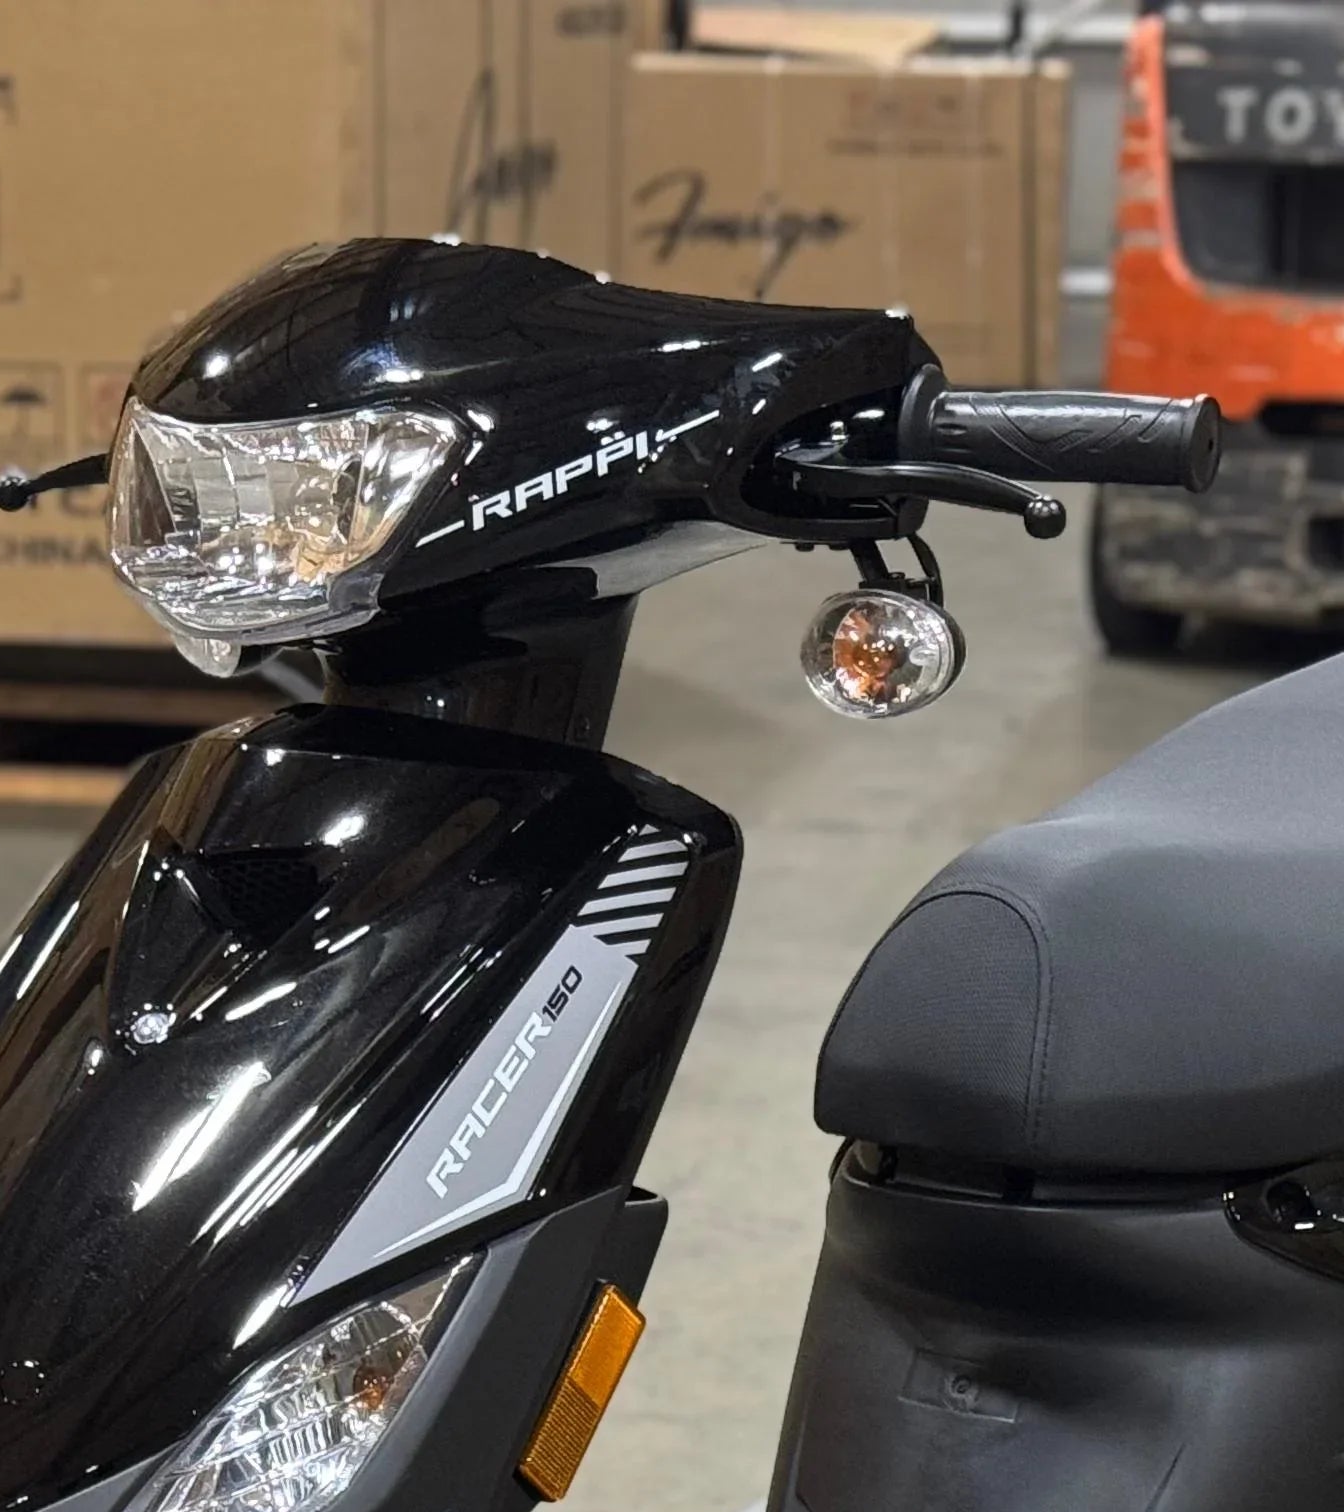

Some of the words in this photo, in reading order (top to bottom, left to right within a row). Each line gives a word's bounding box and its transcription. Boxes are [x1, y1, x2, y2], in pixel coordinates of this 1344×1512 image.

[472, 431, 649, 532] RAPPI
[425, 1010, 553, 1200] RACER
[541, 964, 583, 1023] 150
